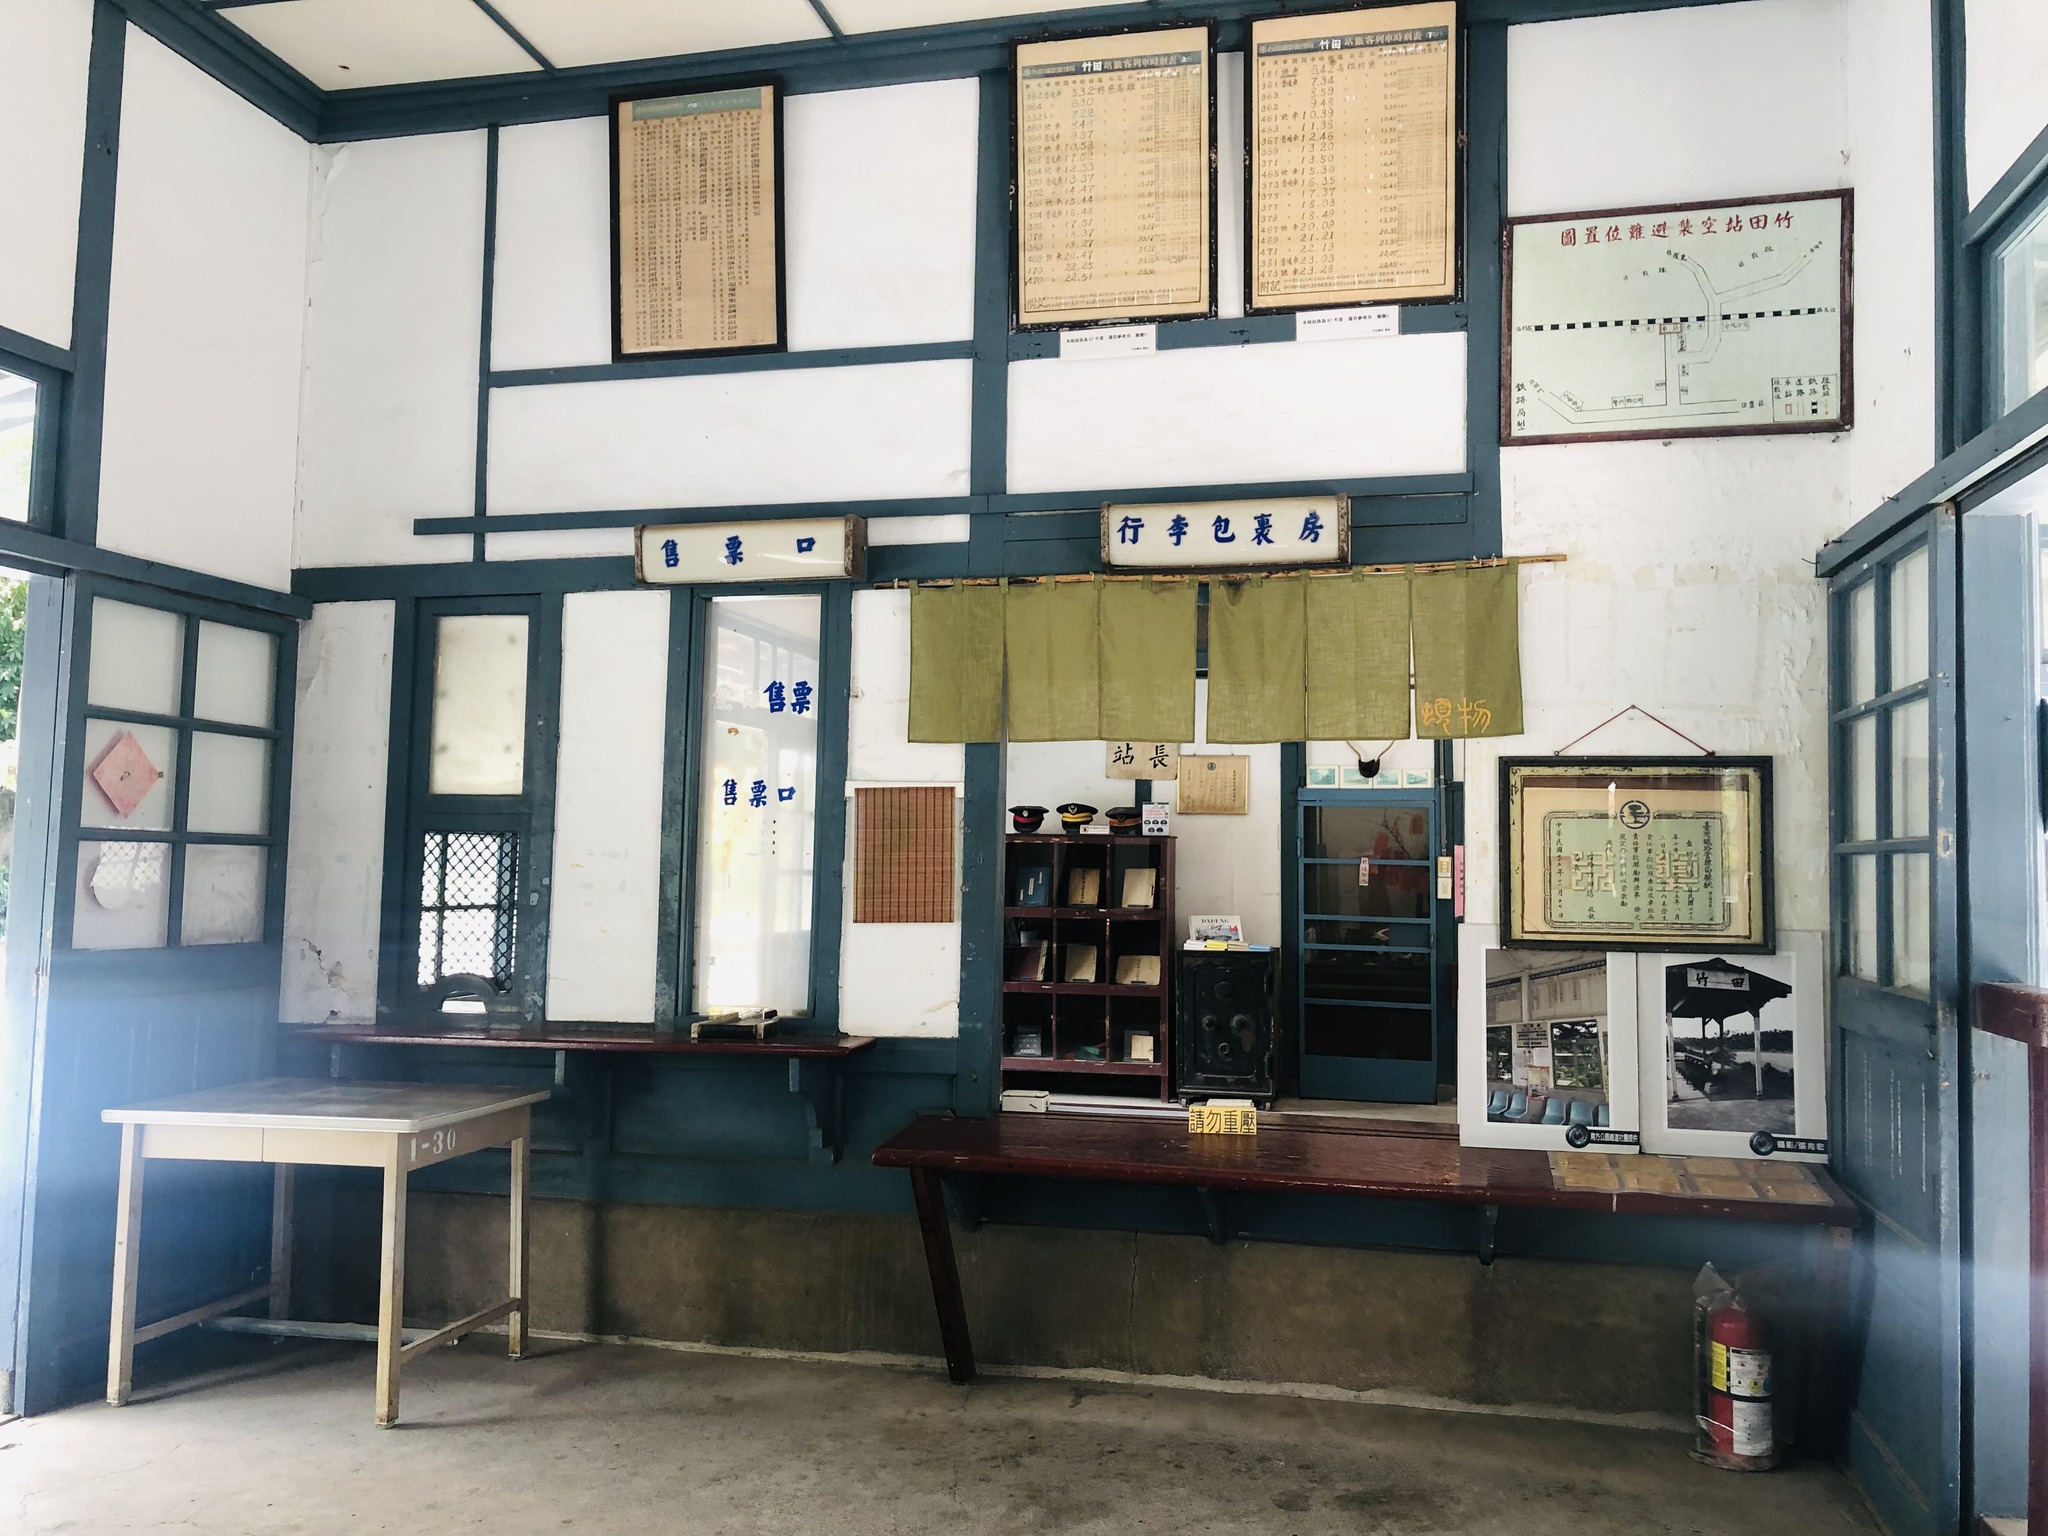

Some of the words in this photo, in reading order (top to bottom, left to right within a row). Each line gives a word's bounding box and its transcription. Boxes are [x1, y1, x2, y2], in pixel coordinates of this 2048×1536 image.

[1311, 75, 1334, 86] 7.34
[1301, 132, 1334, 143] 12.46
[1301, 142, 1334, 153] 13.20
[1301, 155, 1335, 165] 13.50
[1301, 166, 1335, 176] 15.30
[1301, 177, 1336, 187] 16.35
[1301, 187, 1336, 198] 17.37
[1560, 210, 1794, 247] 竹田站空襲避難位置圖
[1300, 231, 1335, 243] 21.21
[1300, 255, 1335, 265] 23.03
[1065, 262, 1094, 272] 22.25
[1065, 273, 1092, 282] 22.51
[1260, 270, 1279, 278] 473
[1117, 506, 1325, 546] 行李包裹房
[661, 536, 816, 568] 售票口
[763, 680, 814, 714] 售票
[1112, 743, 1170, 769] 站長
[721, 778, 797, 808] 售票口
[1696, 972, 1745, 988] 竹田
[1190, 1110, 1257, 1134] 請勿重壓
[410, 1128, 457, 1162] 1-30
